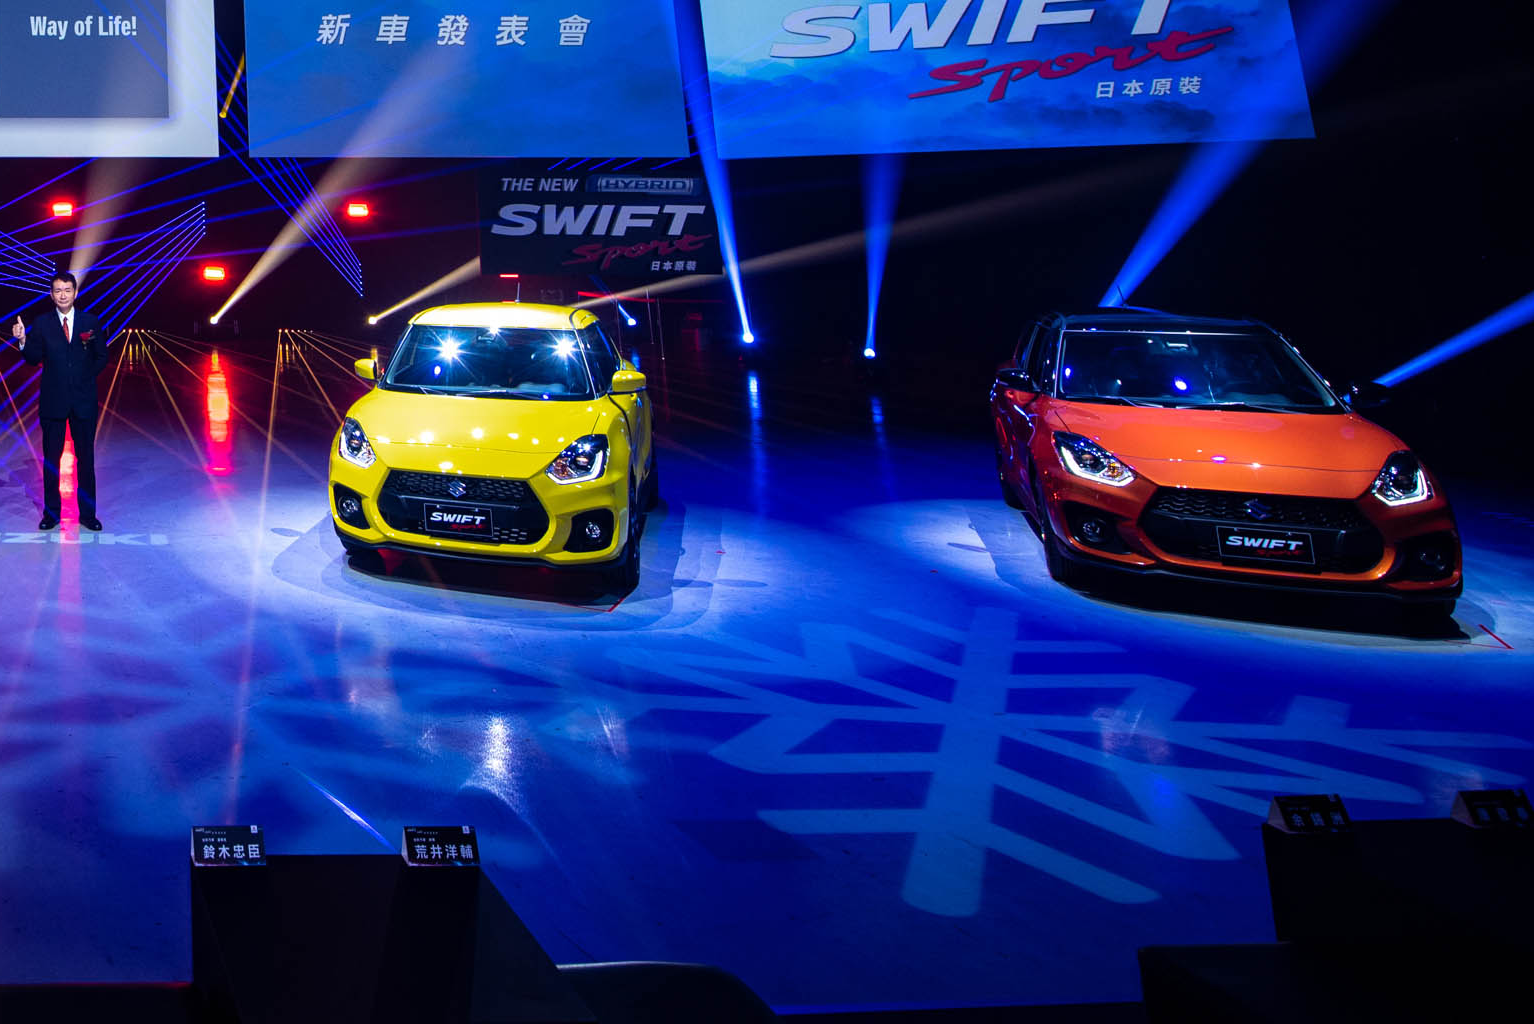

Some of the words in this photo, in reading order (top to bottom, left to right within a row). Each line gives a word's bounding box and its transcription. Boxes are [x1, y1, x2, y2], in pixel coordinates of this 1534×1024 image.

[30, 16, 68, 40] Way
[74, 15, 92, 36] of
[99, 15, 137, 36] Life!
[316, 14, 591, 46] 新車發表會
[1096, 76, 1203, 98] 日本原裝
[501, 178, 535, 192] THE
[538, 178, 579, 192] NEW
[602, 179, 687, 191] HYBRID
[490, 204, 706, 236] SWIFT
[651, 261, 697, 272] 日本原裝
[430, 511, 486, 525] SWIFT
[1226, 535, 1304, 551] SWIFT
[203, 844, 261, 859] 鈴木忠臣
